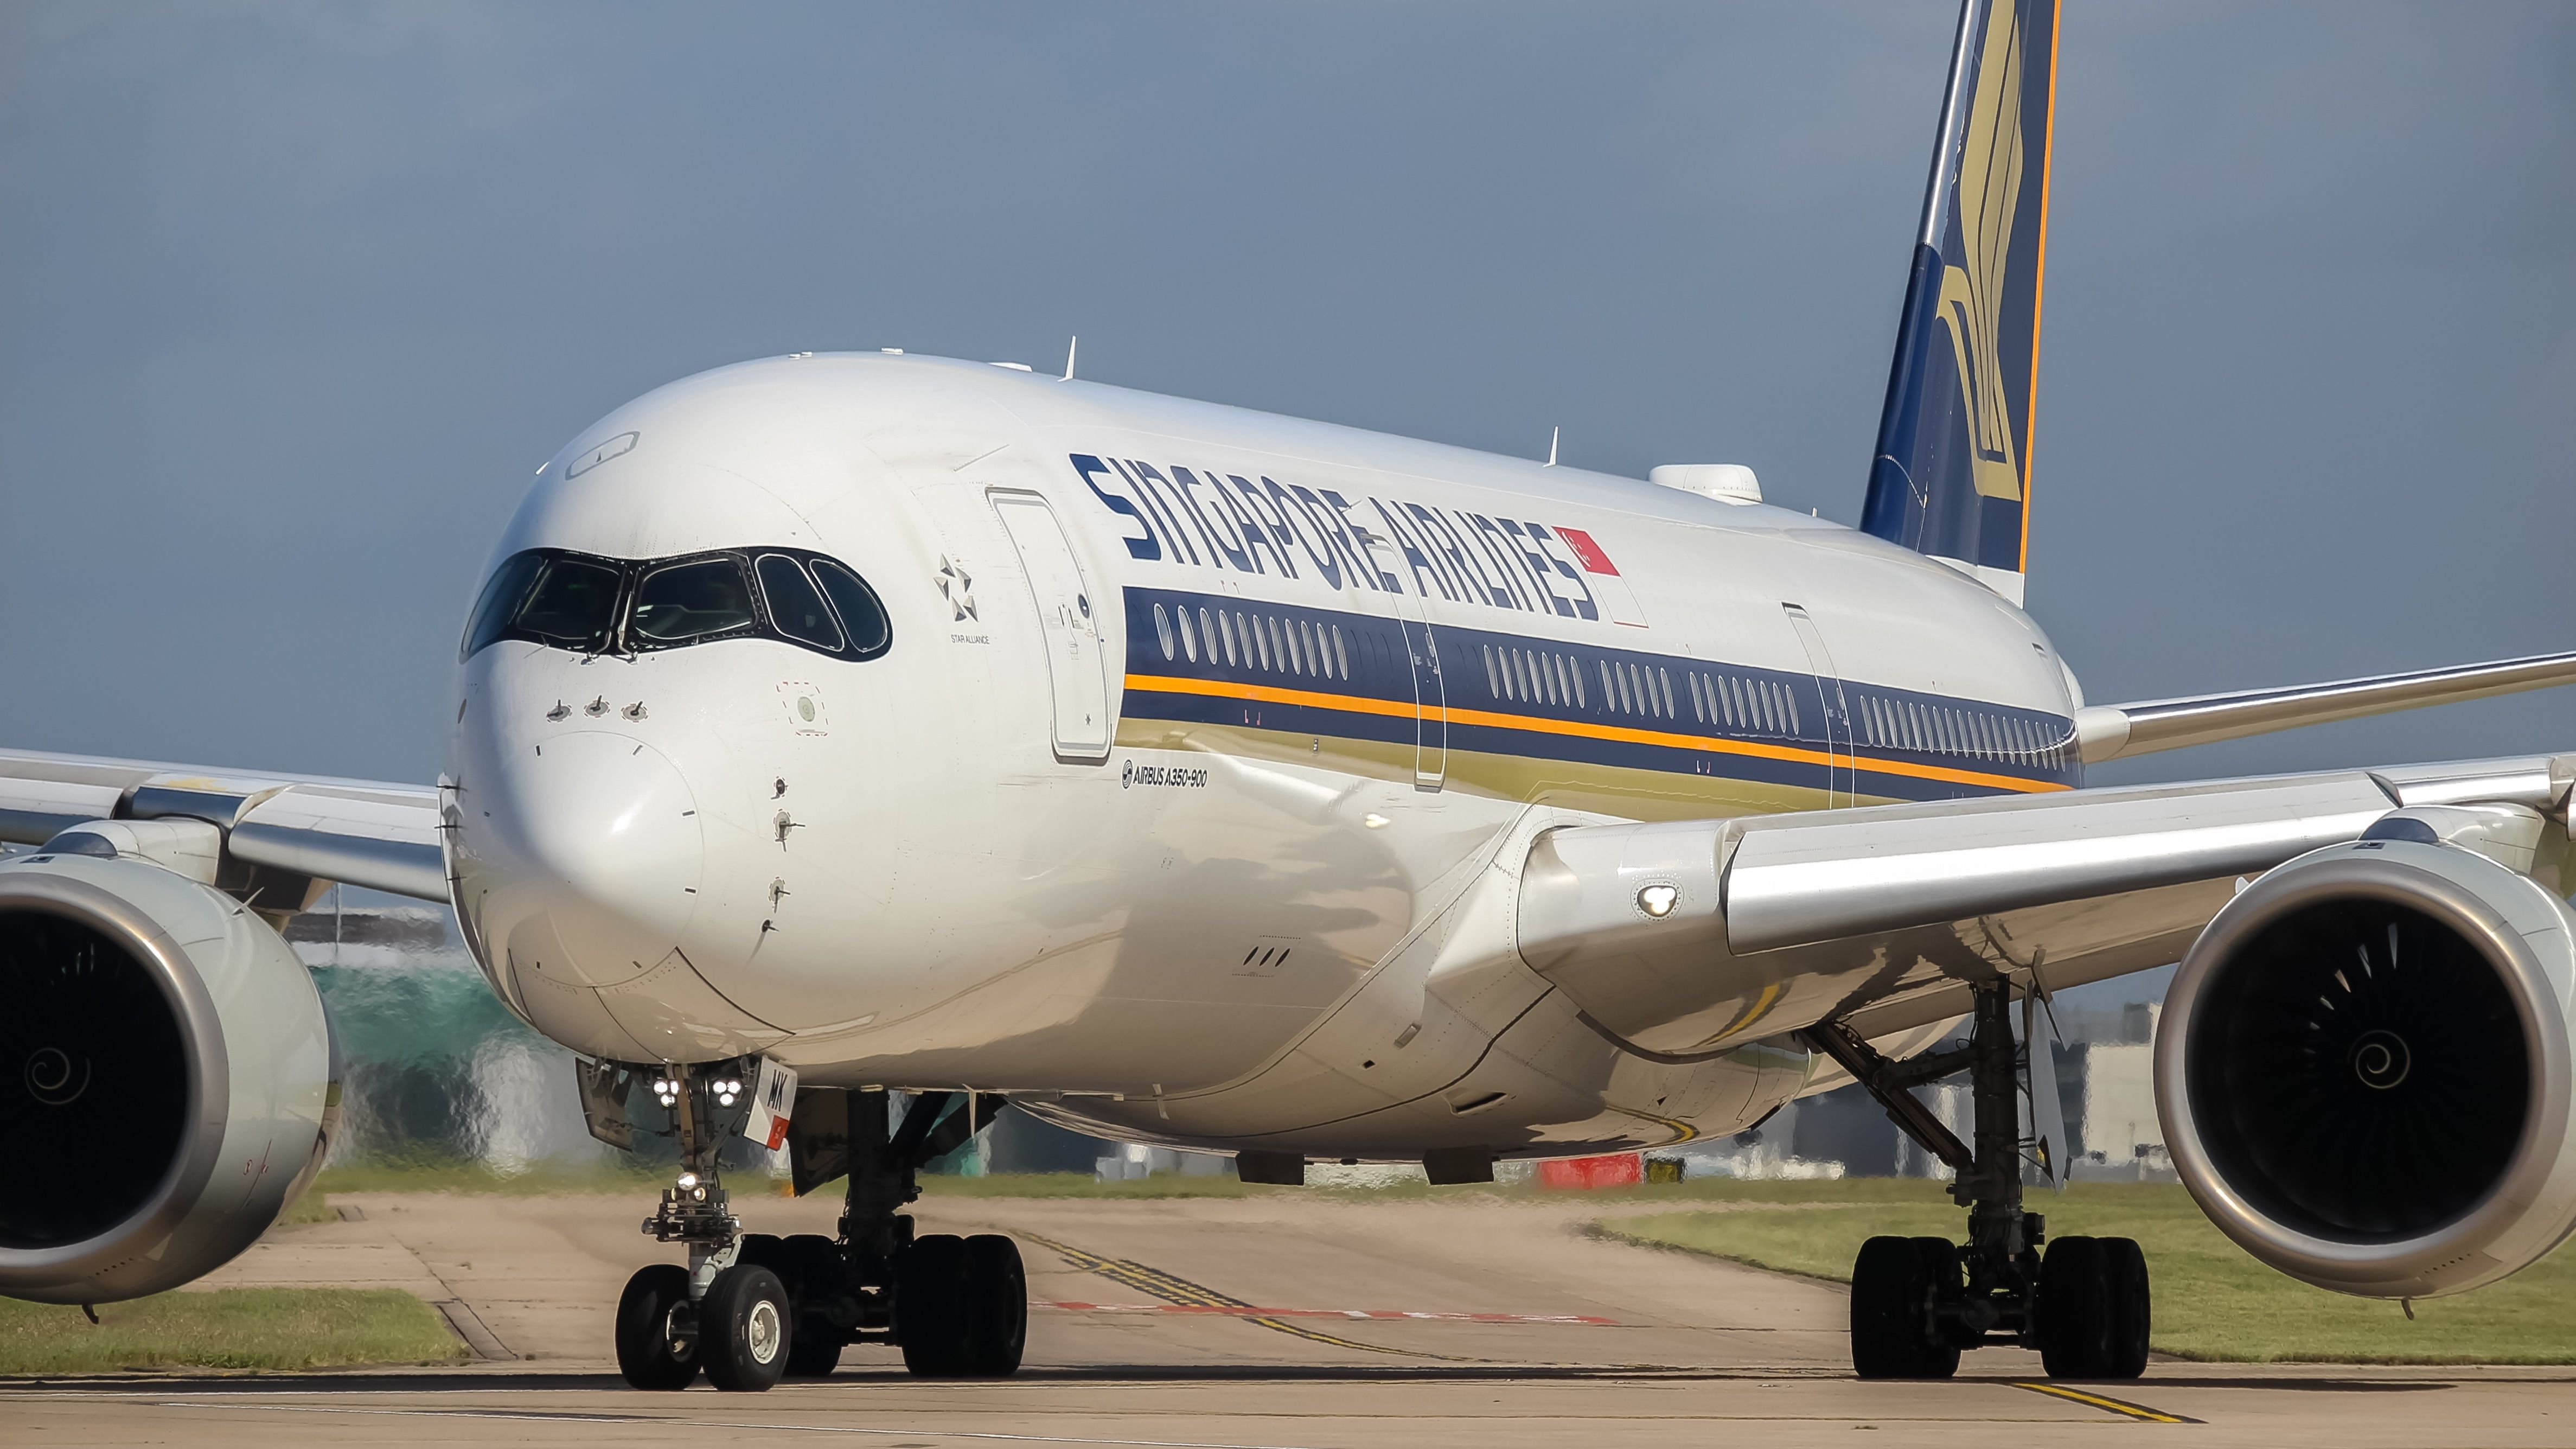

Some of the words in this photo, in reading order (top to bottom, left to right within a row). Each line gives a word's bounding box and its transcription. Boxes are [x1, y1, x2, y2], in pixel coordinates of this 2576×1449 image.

[1069, 452, 1404, 595] SINGAPORE
[1367, 496, 1599, 621] AIRLINES
[951, 634, 965, 643] STAR
[966, 635, 990, 644] ALLIANCE
[1133, 765, 1165, 786] AIRBUS
[1164, 768, 1207, 788] A350-900
[768, 1069, 788, 1112] MK
